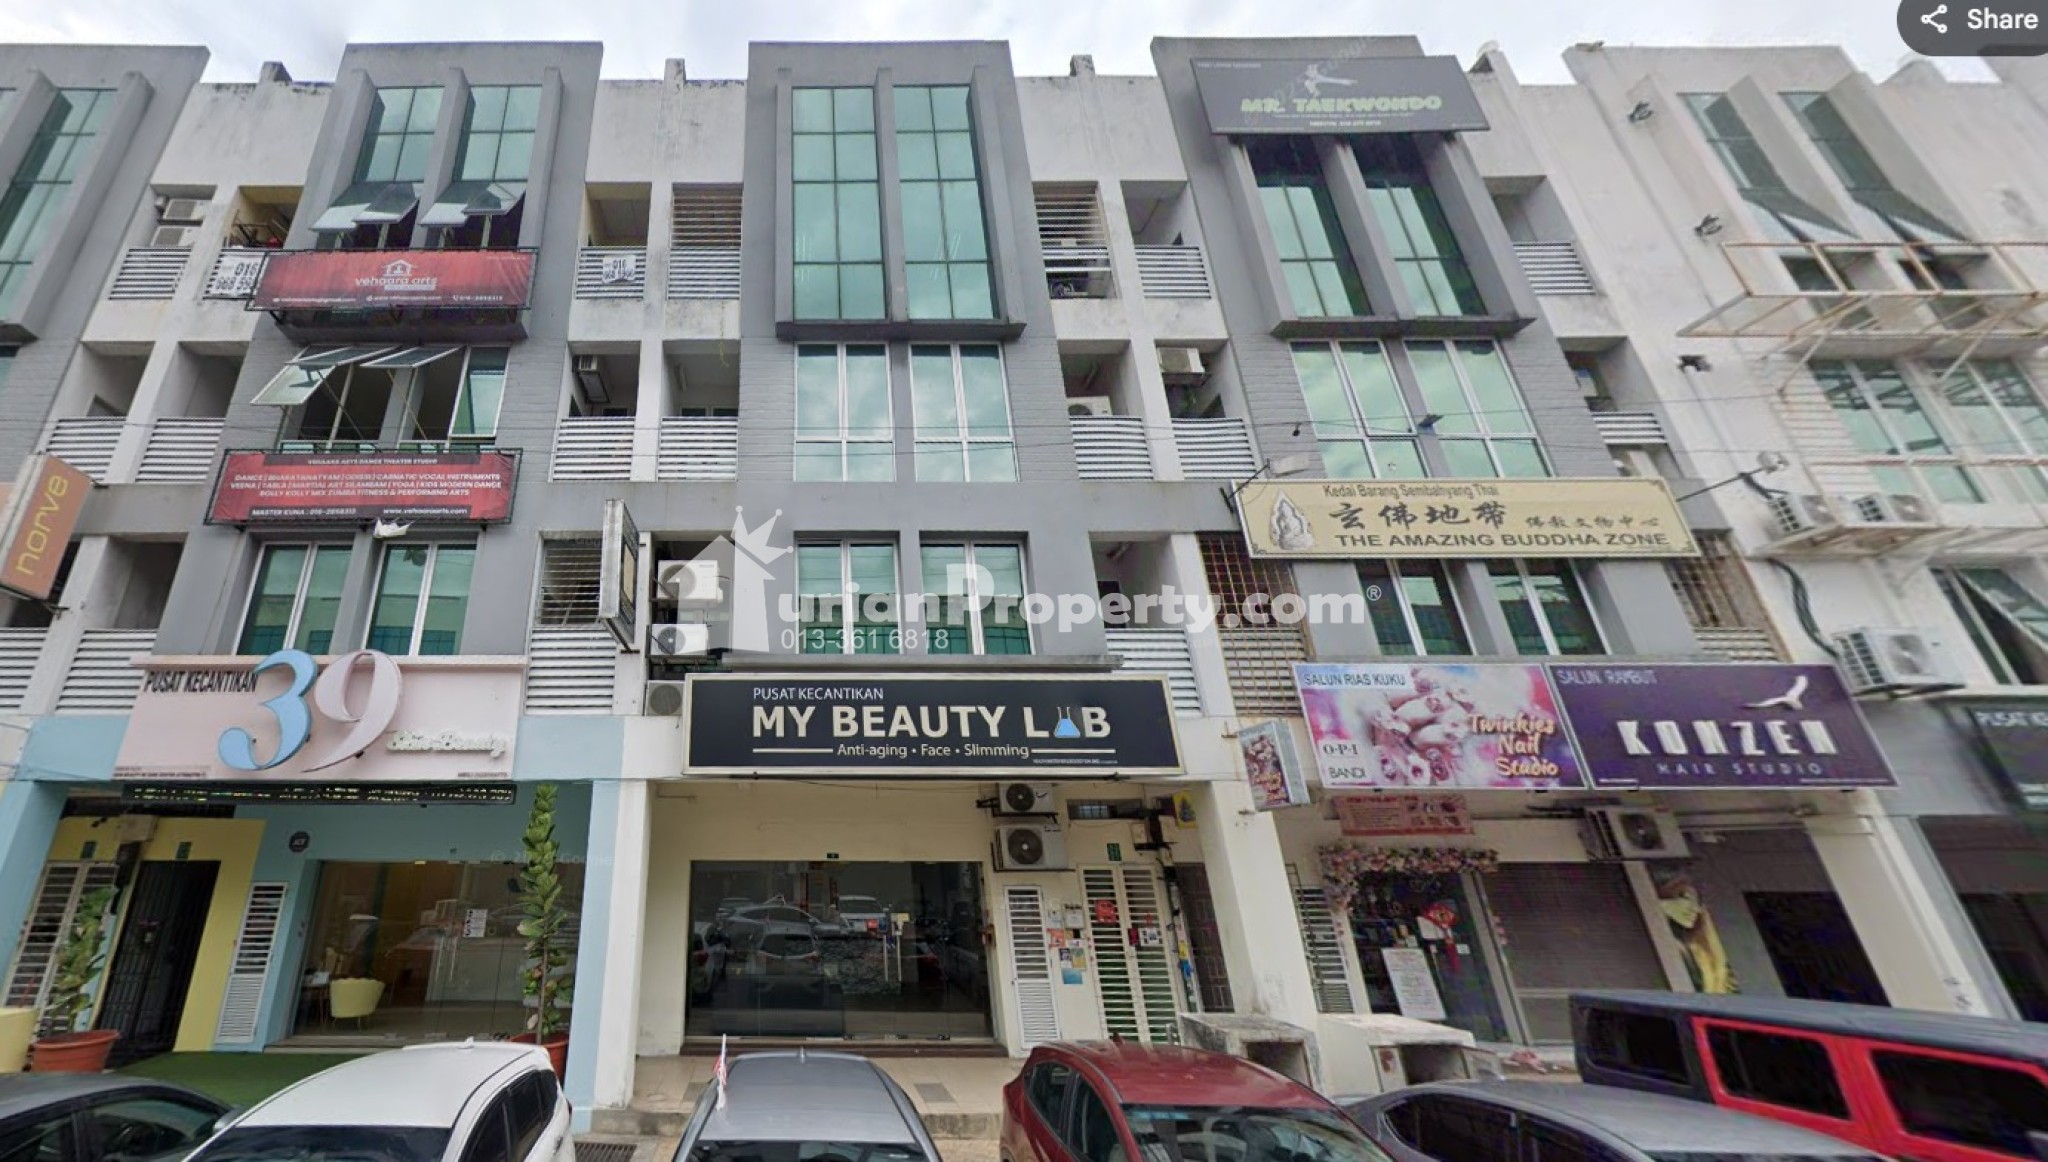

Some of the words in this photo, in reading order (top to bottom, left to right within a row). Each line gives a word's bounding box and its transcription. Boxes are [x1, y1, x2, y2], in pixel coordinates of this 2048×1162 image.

[1241, 97, 1285, 113] MR.
[1292, 95, 1443, 113] TAEKWONDO
[411, 276, 438, 286] arts
[234, 473, 263, 481] DANCE
[418, 473, 446, 481] VOCAL
[447, 473, 500, 481] INSTRUMENTS
[327, 481, 343, 489] ART
[391, 481, 415, 489] YOGA
[420, 481, 438, 489] KIDS
[439, 481, 474, 489] MODERN
[473, 481, 502, 489] DANCE
[1323, 485, 1357, 497] Kedai
[1358, 484, 1400, 499] Barang
[1400, 484, 1473, 499] Sembahyang
[1473, 484, 1499, 497] Thai
[15, 474, 69, 577] norve
[1335, 534, 1383, 547] THE
[1389, 534, 1495, 547] AMAZING
[1501, 533, 1600, 546] BUDDHA
[1604, 533, 1671, 546] ZONE
[143, 669, 183, 693] PUSAT
[184, 670, 259, 693] KECANTIKAN
[1303, 673, 1344, 686] SALUN
[1345, 674, 1372, 686] RIAS
[1372, 674, 1407, 686] KUKU
[1556, 669, 1603, 684] SALUN
[1606, 669, 1658, 685] RAMBUT
[753, 687, 797, 700] PUSAT
[798, 687, 884, 701] KECANTIKAN
[217, 648, 402, 772] 39
[752, 704, 816, 738] MY
[831, 704, 1006, 738] BEAUTY
[1468, 713, 1555, 735] Twinkies
[1498, 733, 1541, 754] Nail
[1616, 719, 1838, 755] KONZEN
[837, 743, 908, 759] Anti-aging
[920, 743, 952, 757] Face
[963, 743, 1030, 759] Slimming
[1496, 756, 1559, 777] Studio
[1656, 763, 1717, 775] HAIR
[1732, 762, 1824, 775] STUDIO
